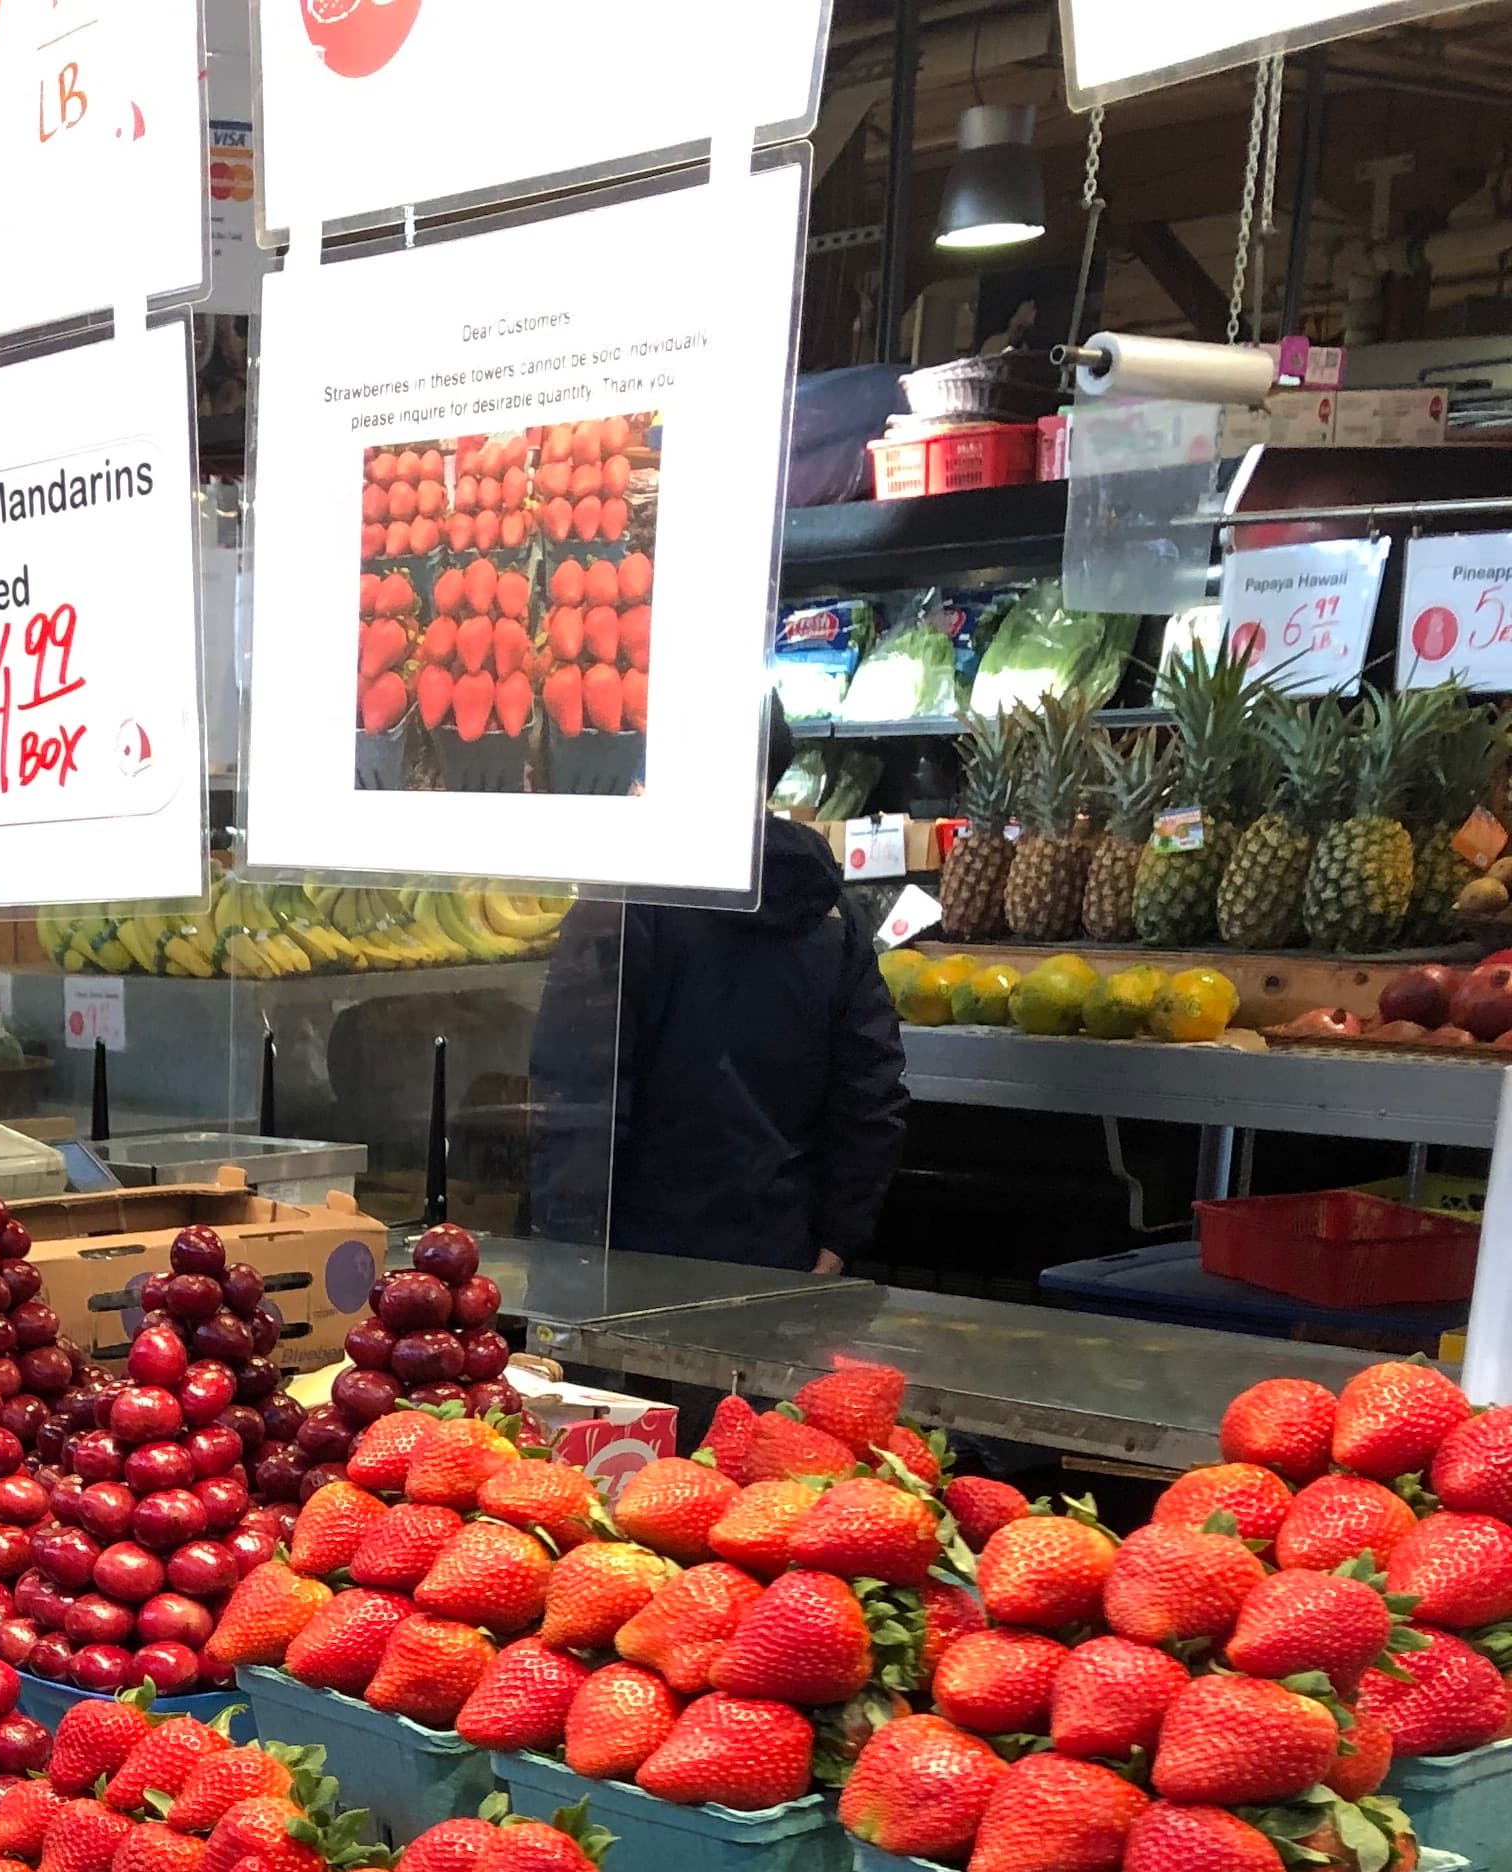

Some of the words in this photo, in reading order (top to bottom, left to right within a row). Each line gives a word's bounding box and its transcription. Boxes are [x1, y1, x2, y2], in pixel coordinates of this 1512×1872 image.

[39, 62, 88, 143] LB
[214, 132, 247, 147] VISA
[462, 323, 492, 343] Dear
[323, 376, 410, 404] Strawberries
[431, 370, 467, 391] these
[471, 364, 515, 383] towers
[351, 410, 395, 433] please
[399, 401, 446, 427] inquire
[450, 399, 469, 418] for
[472, 390, 533, 415] desirable
[604, 373, 644, 396] Thank
[1245, 575, 1294, 594] Papaya
[1298, 572, 1348, 589] Hawaii
